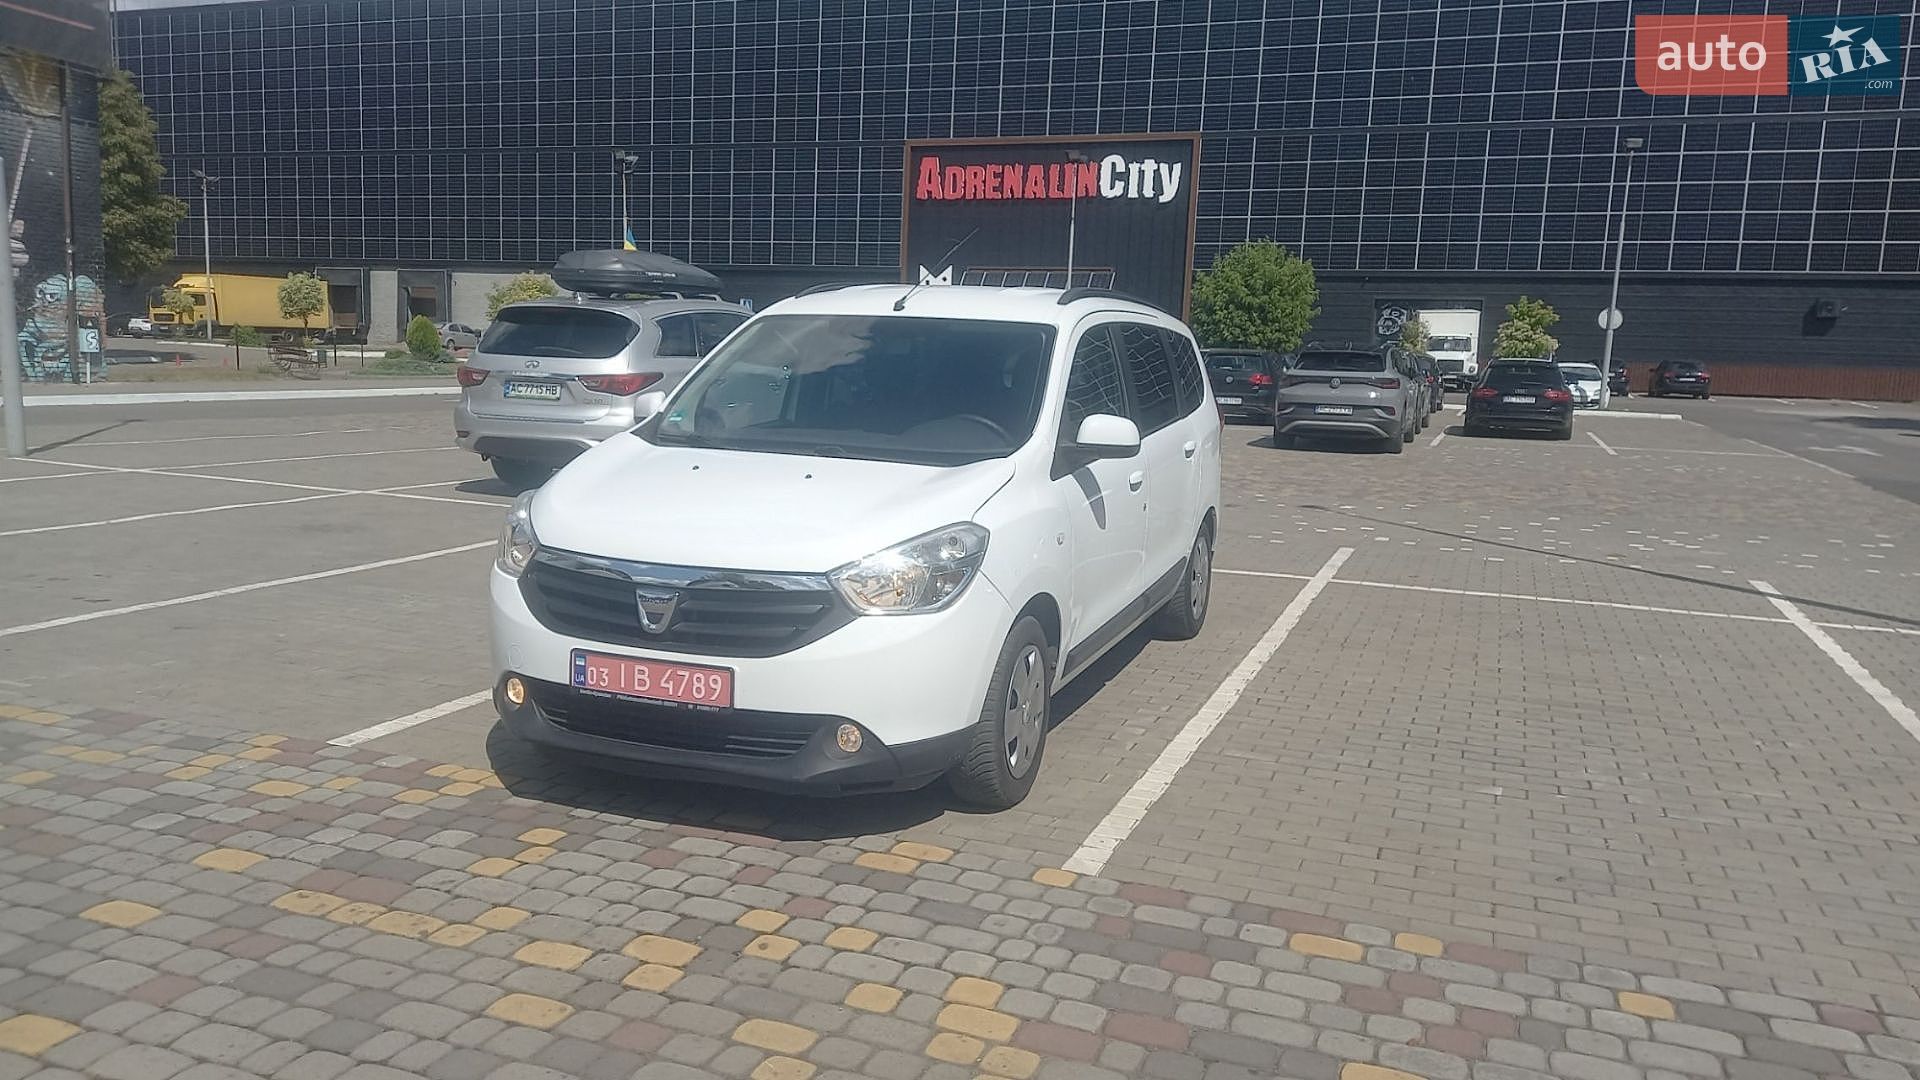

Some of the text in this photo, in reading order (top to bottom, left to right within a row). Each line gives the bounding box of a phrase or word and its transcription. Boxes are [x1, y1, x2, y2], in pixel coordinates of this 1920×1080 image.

[575, 673, 585, 683] UA
[587, 667, 609, 687] 03
[660, 669, 722, 701] 4789
